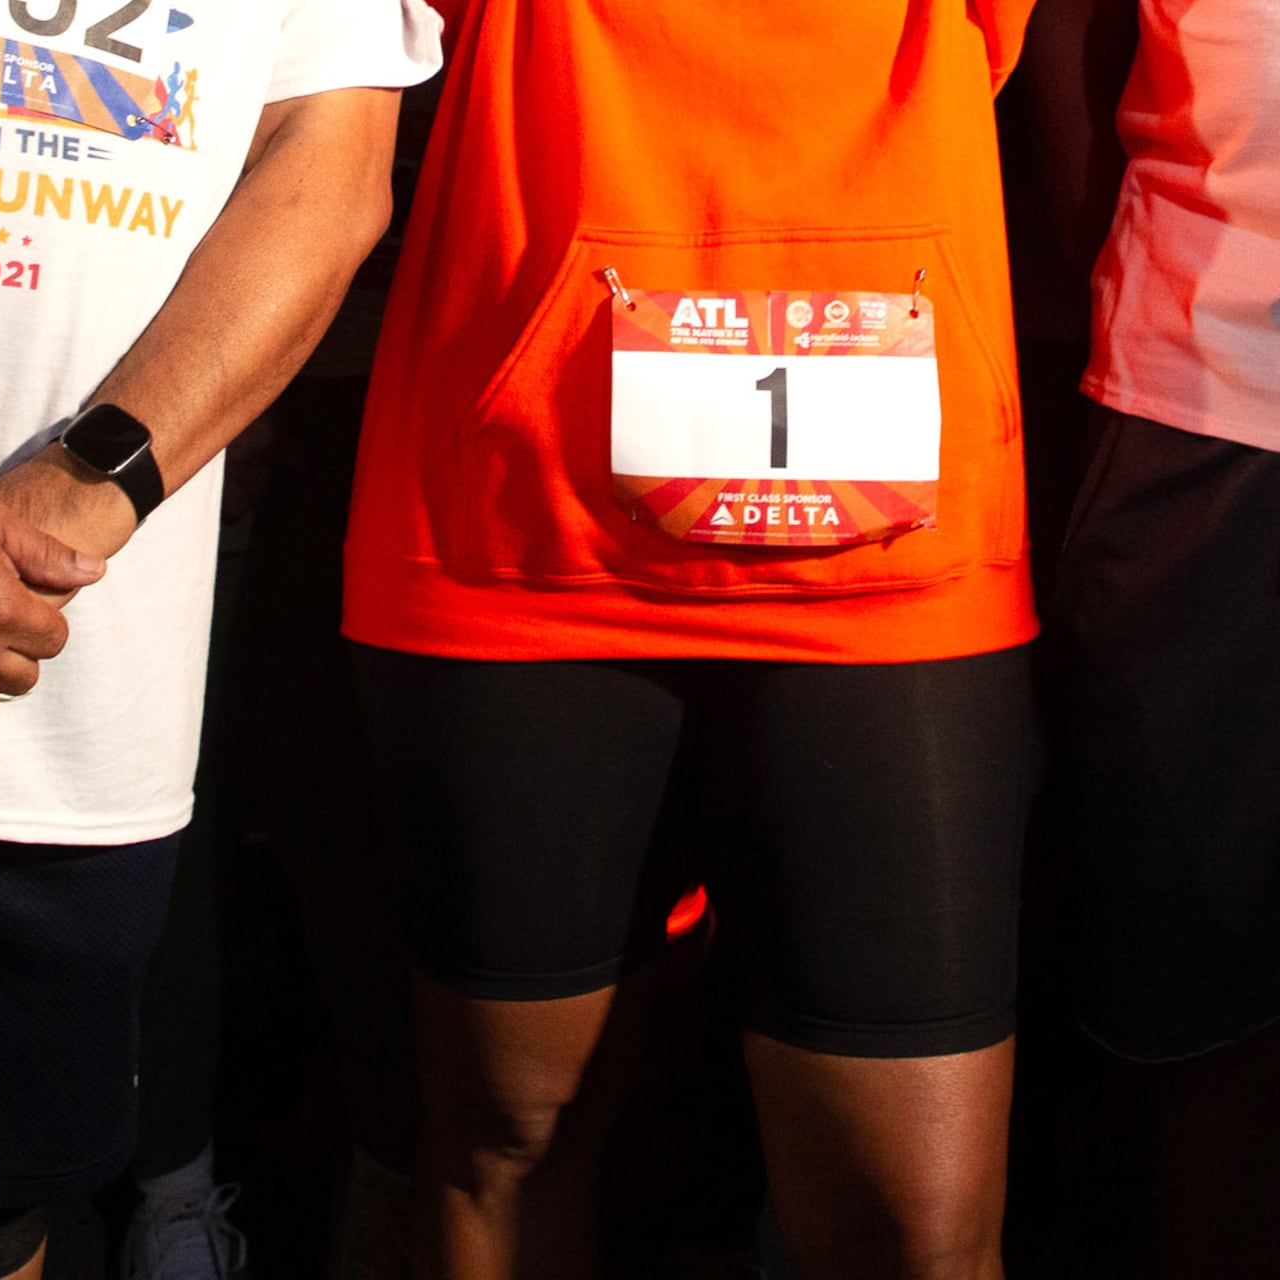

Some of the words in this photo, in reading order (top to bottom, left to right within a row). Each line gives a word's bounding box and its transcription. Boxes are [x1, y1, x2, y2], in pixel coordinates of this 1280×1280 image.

[3, 52, 55, 73] SPONSOR
[15, 129, 81, 162] THE
[670, 298, 749, 328] ATL
[756, 367, 788, 468] 1
[718, 492, 745, 503] FIRST
[747, 493, 781, 504] CLASS
[783, 494, 833, 505] SPONSOR
[743, 505, 840, 526] DELTA
